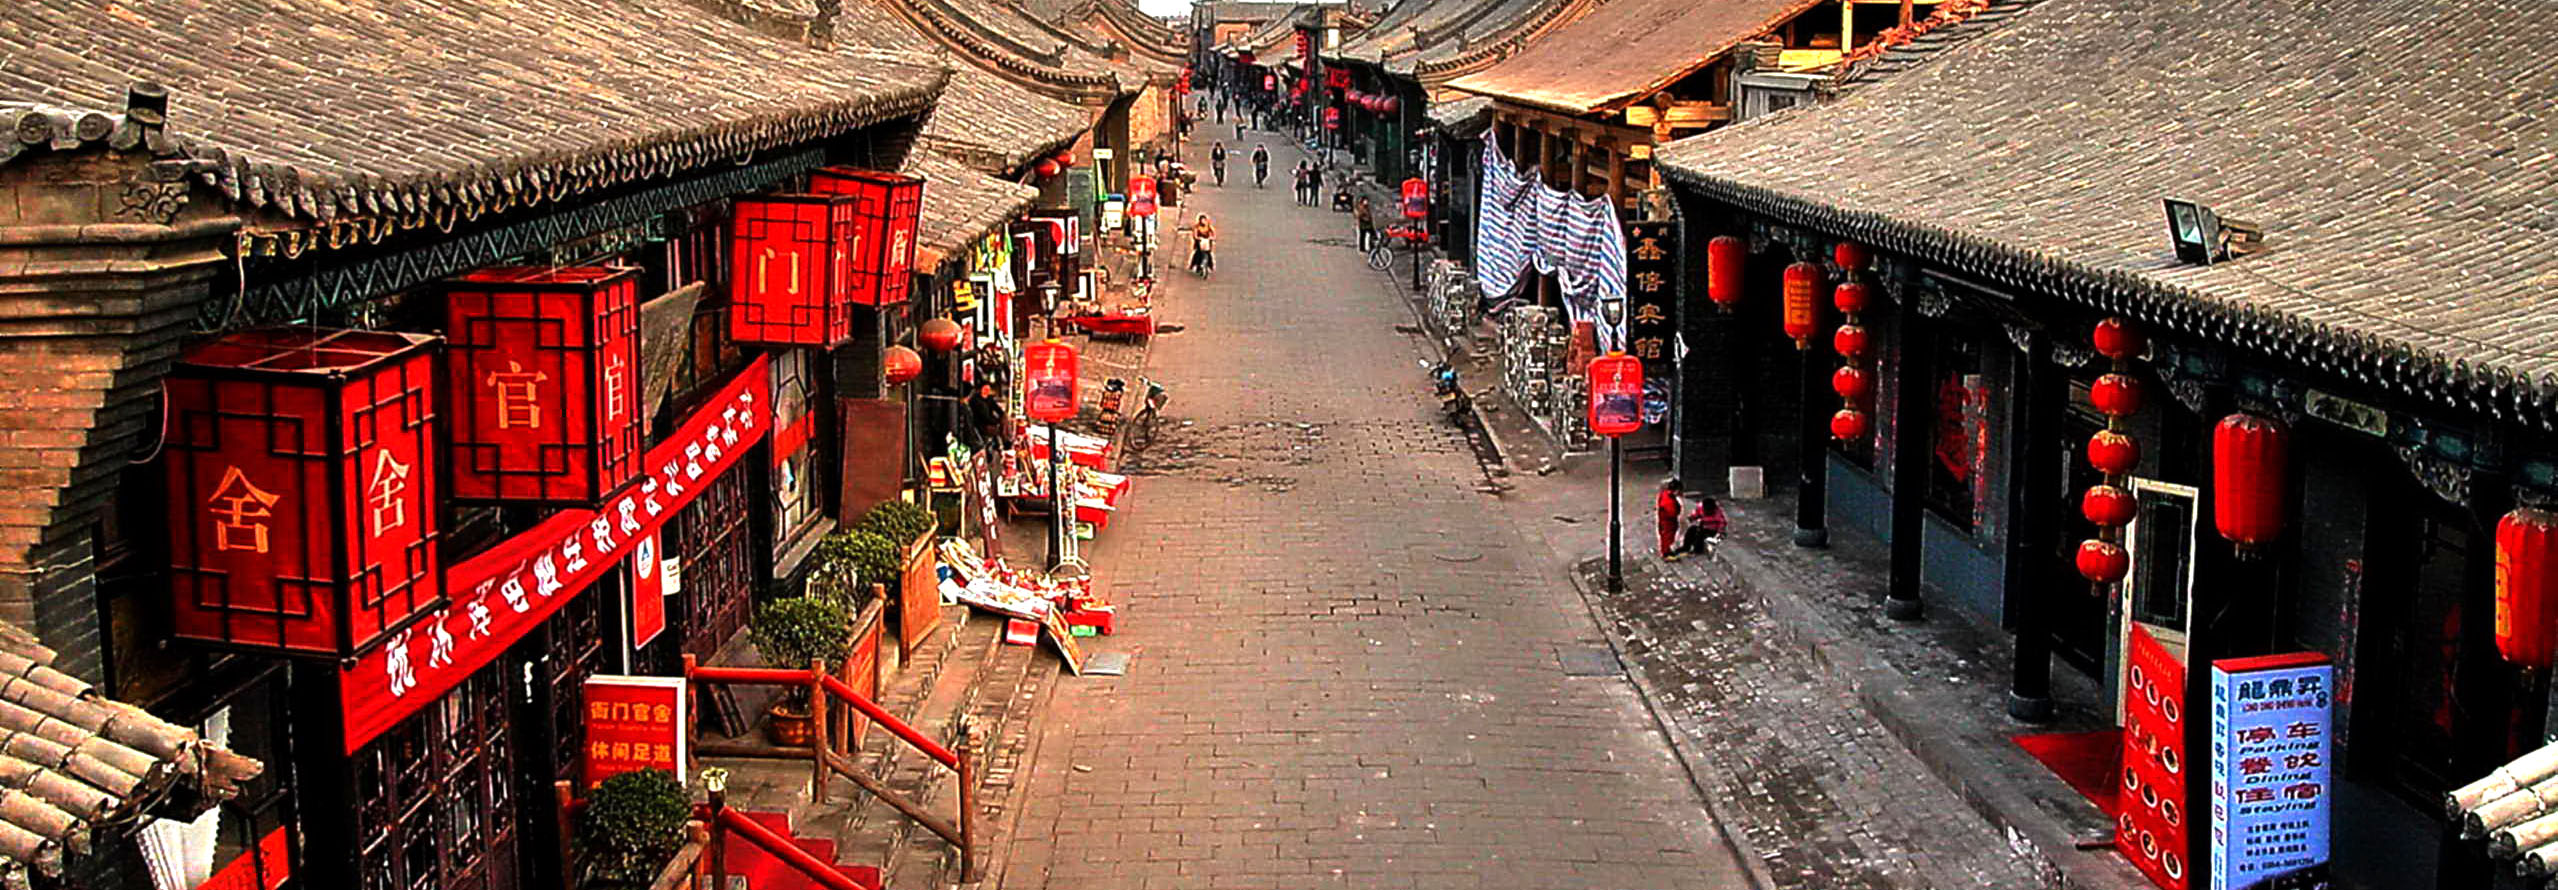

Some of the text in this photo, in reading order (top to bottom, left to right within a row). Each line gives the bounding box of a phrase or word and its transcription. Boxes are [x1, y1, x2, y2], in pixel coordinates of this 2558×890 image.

[758, 247, 800, 295] 门
[486, 360, 549, 430] 官
[604, 353, 625, 422] 官
[208, 464, 281, 554] 舍
[367, 447, 411, 539] 舍
[590, 740, 673, 765] 休闲足道
[2239, 740, 2321, 755] Parking
[2245, 771, 2313, 784] Dining
[2239, 800, 2317, 815] Staying
